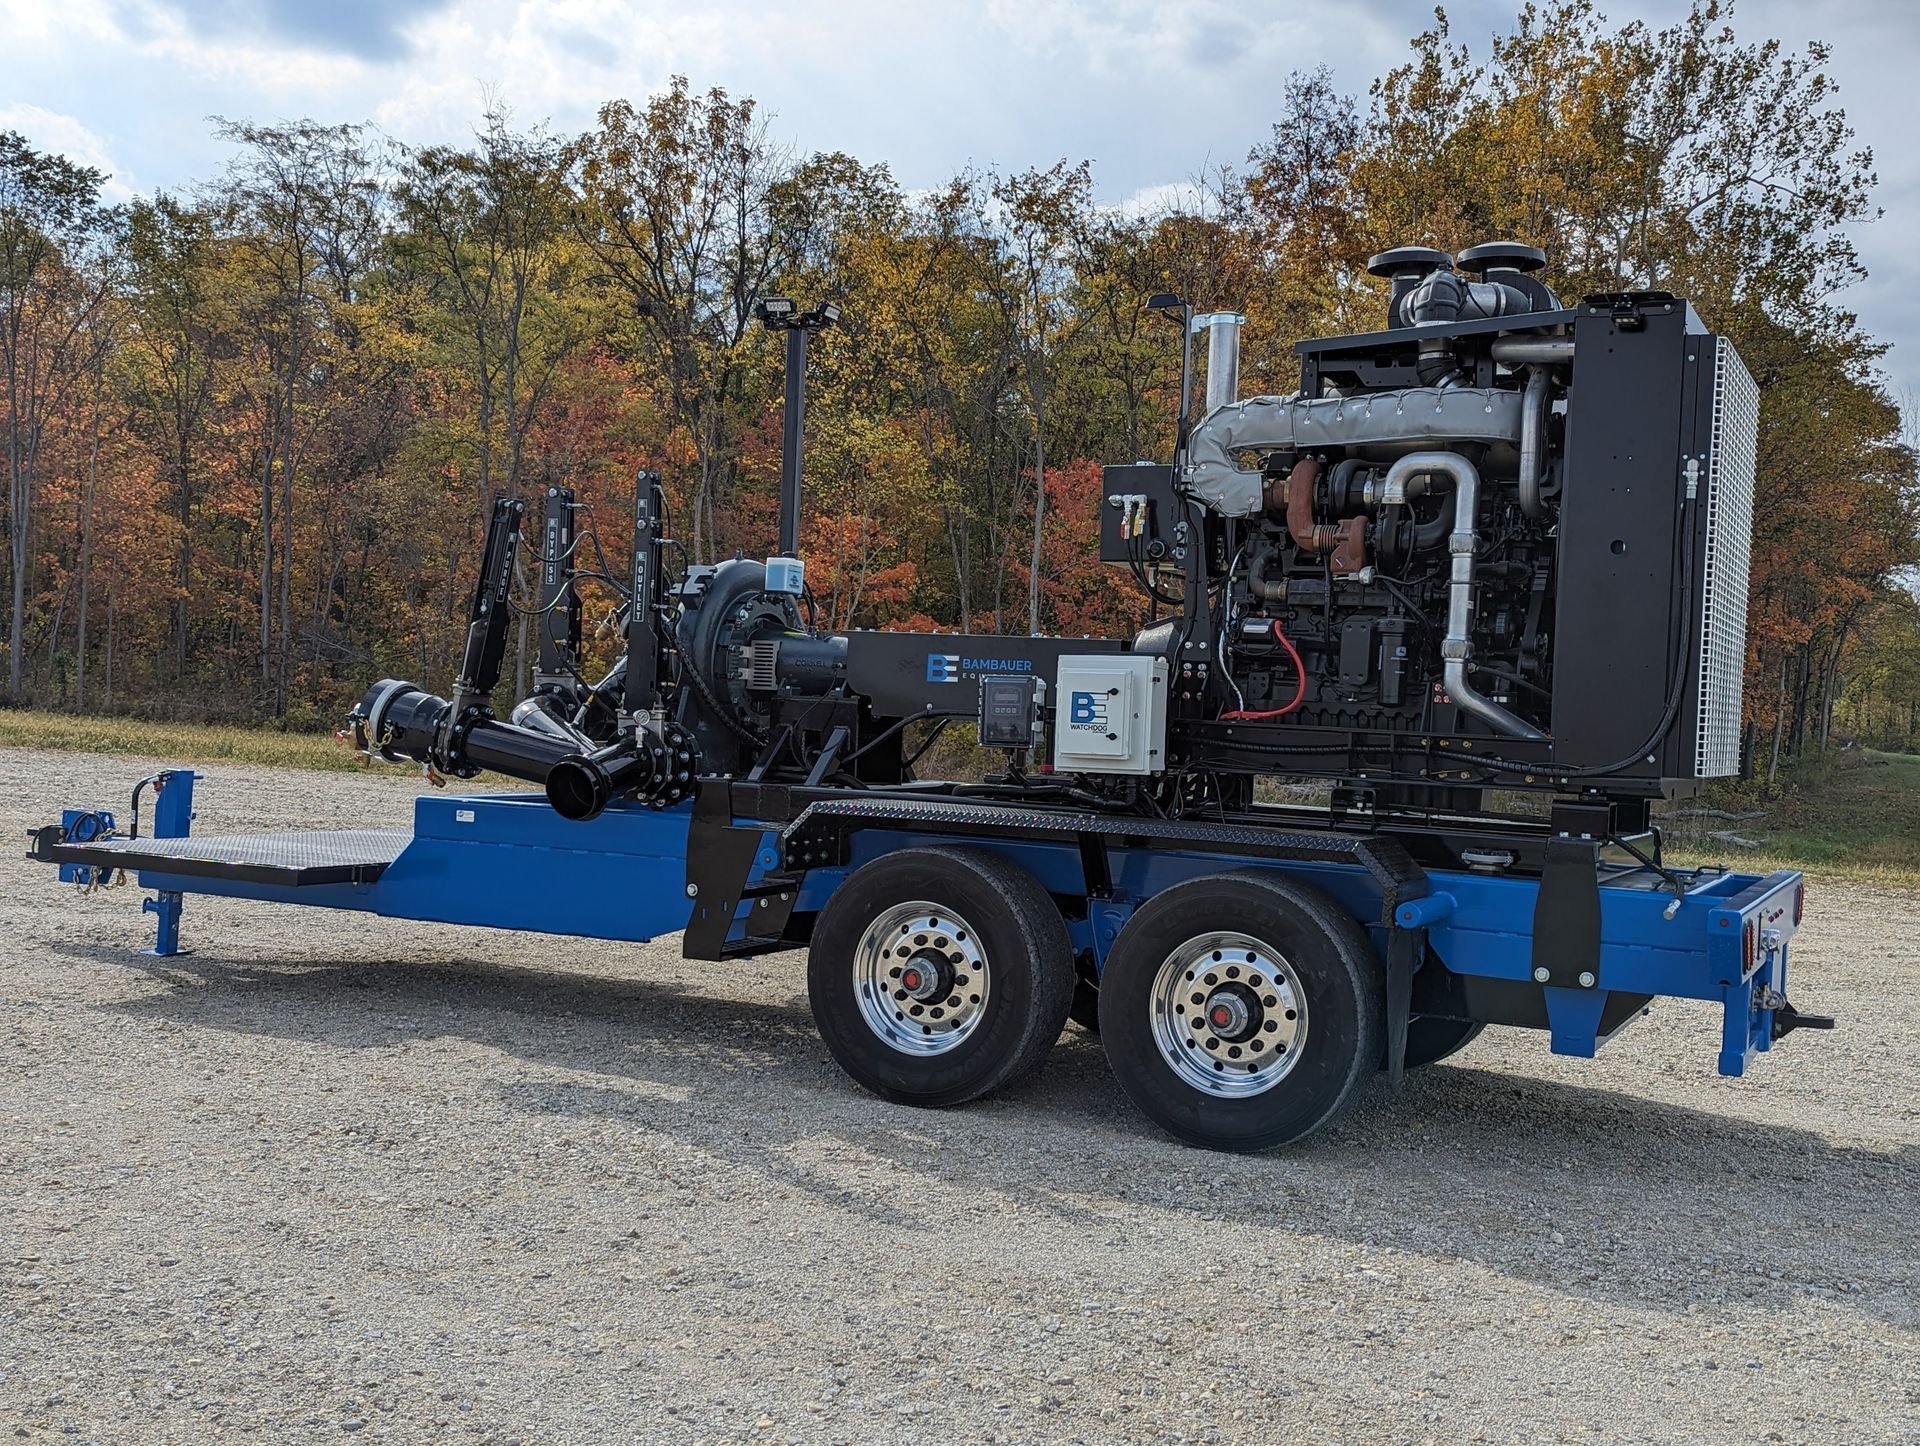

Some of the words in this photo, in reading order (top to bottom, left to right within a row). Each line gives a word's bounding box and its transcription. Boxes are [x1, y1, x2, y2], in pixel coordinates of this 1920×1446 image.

[500, 551, 512, 595] PURGE
[636, 566, 644, 620] OUTLET
[927, 654, 960, 682] BE
[962, 659, 1032, 671] BAMBAUER
[1071, 691, 1109, 724] BE
